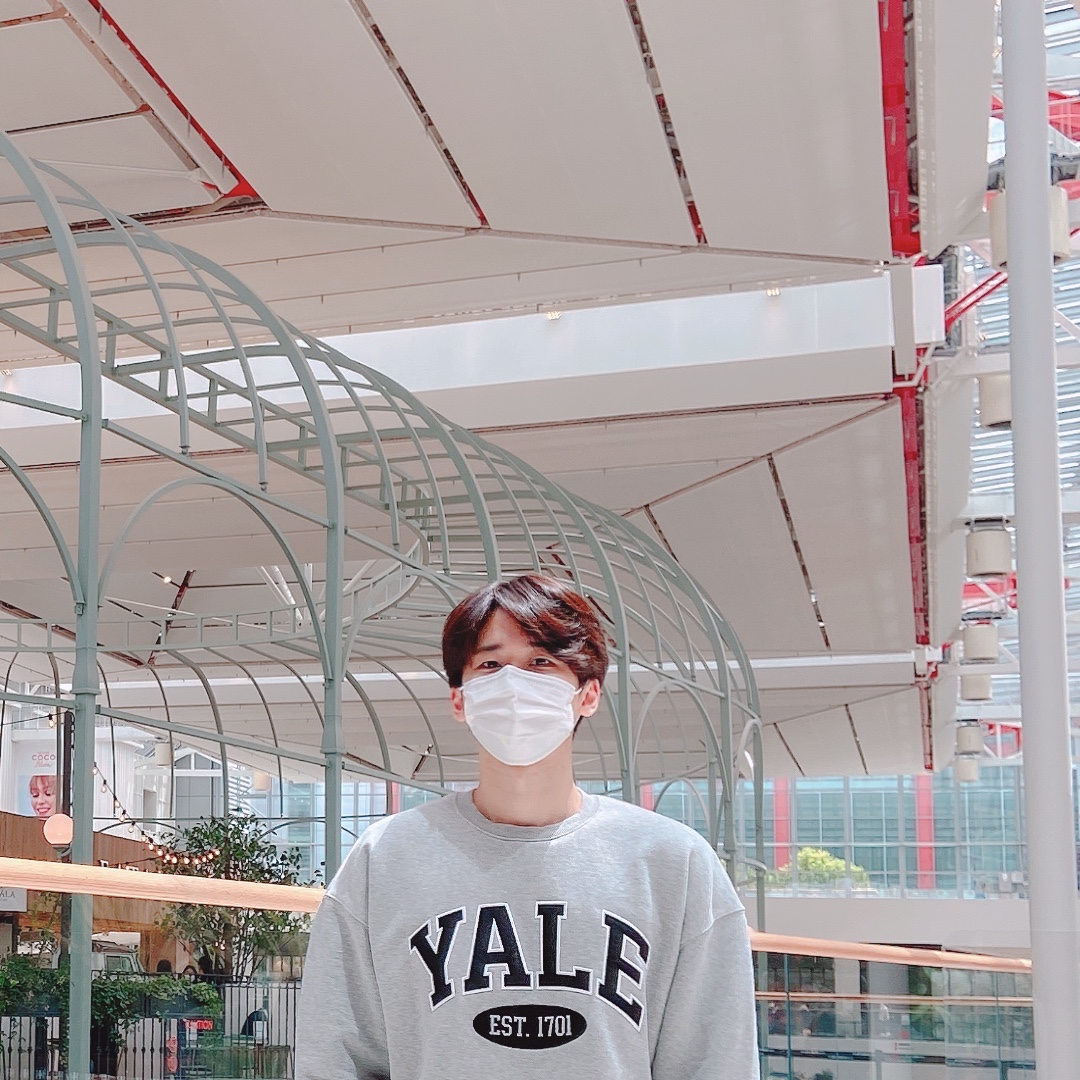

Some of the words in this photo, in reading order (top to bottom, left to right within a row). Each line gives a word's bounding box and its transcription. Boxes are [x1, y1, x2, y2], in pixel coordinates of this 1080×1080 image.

[408, 900, 651, 1032] YALE
[489, 1014, 530, 1038] EST.
[537, 1014, 572, 1038] 1701
